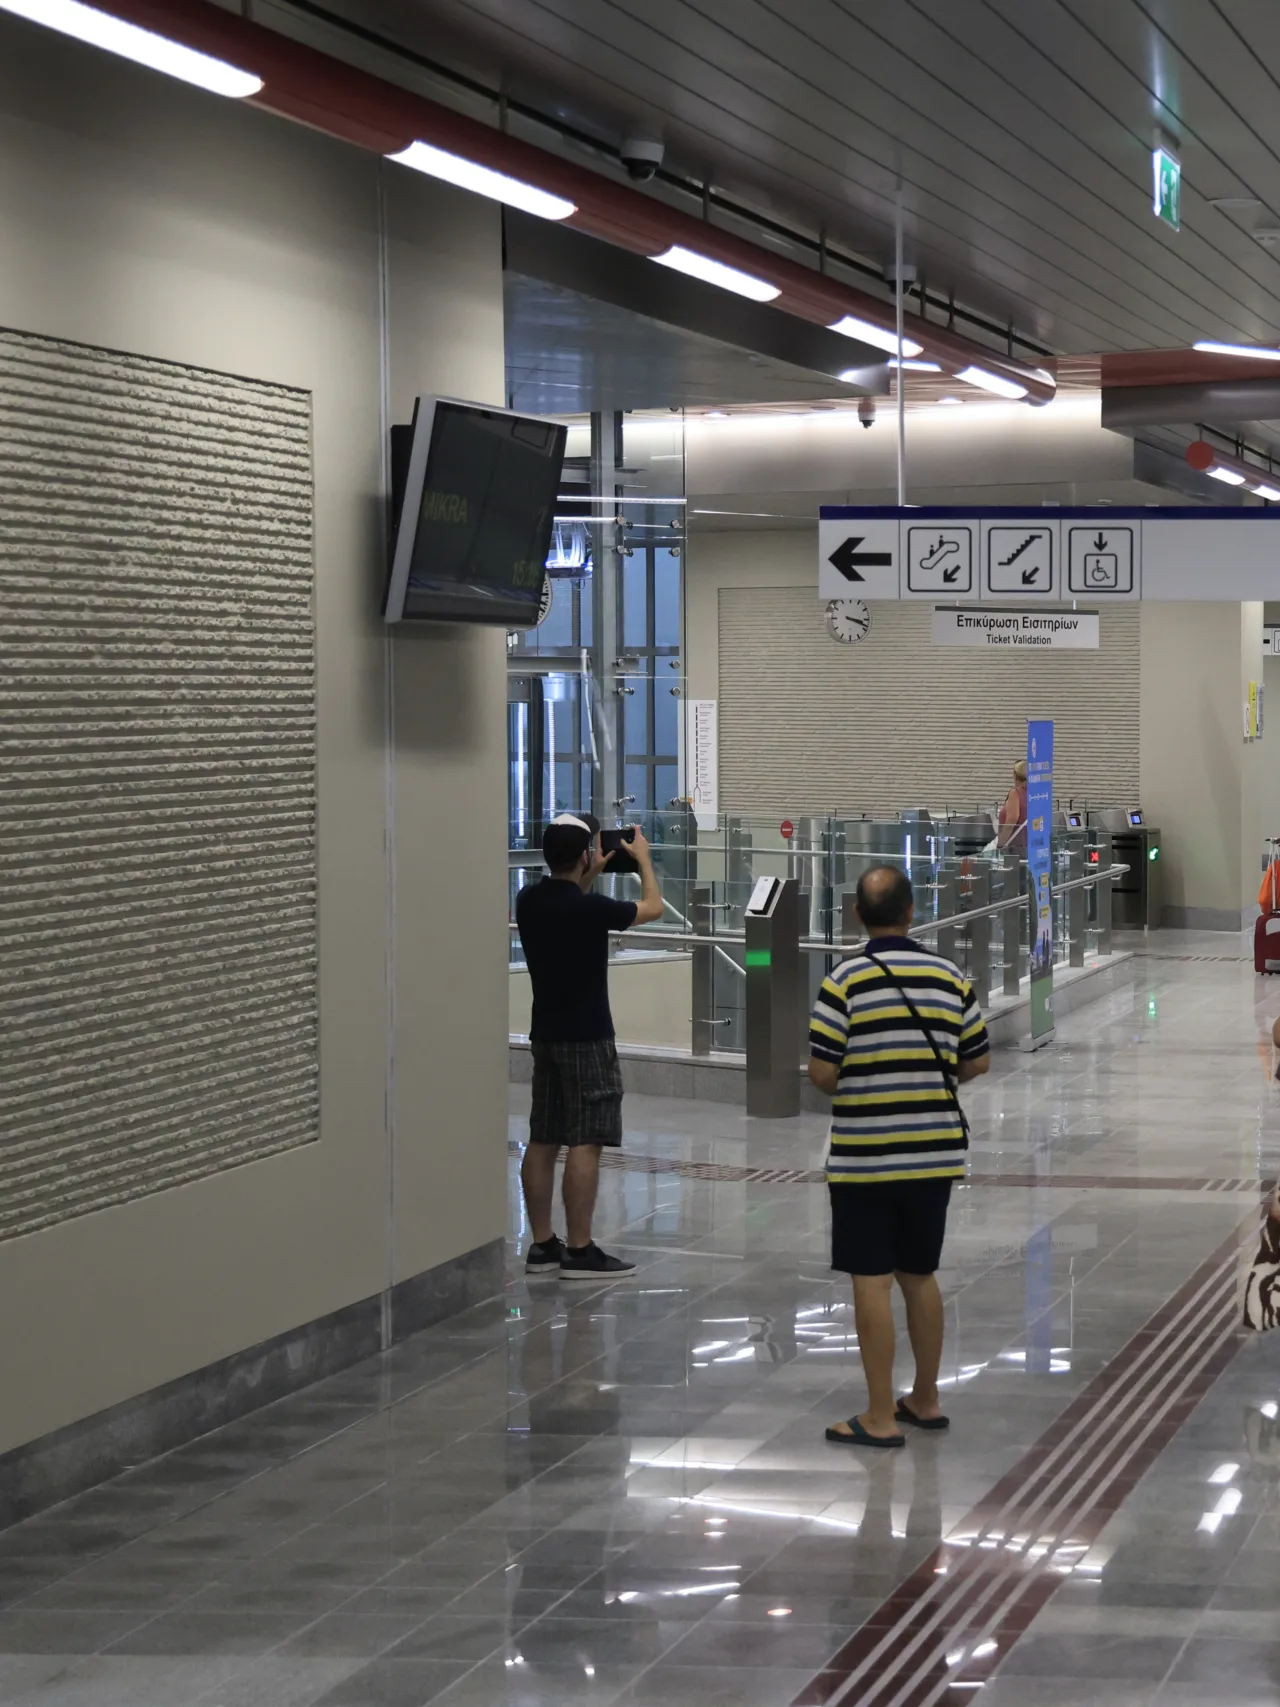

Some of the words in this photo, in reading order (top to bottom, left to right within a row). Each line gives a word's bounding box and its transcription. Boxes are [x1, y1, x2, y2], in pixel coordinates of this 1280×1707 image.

[423, 491, 469, 523] MIKRA
[956, 614, 1019, 631] Επικύρωση
[1022, 616, 1078, 632] Εισιτηρίων
[986, 634, 1011, 644] Ticket
[1012, 635, 1052, 645] Validation
